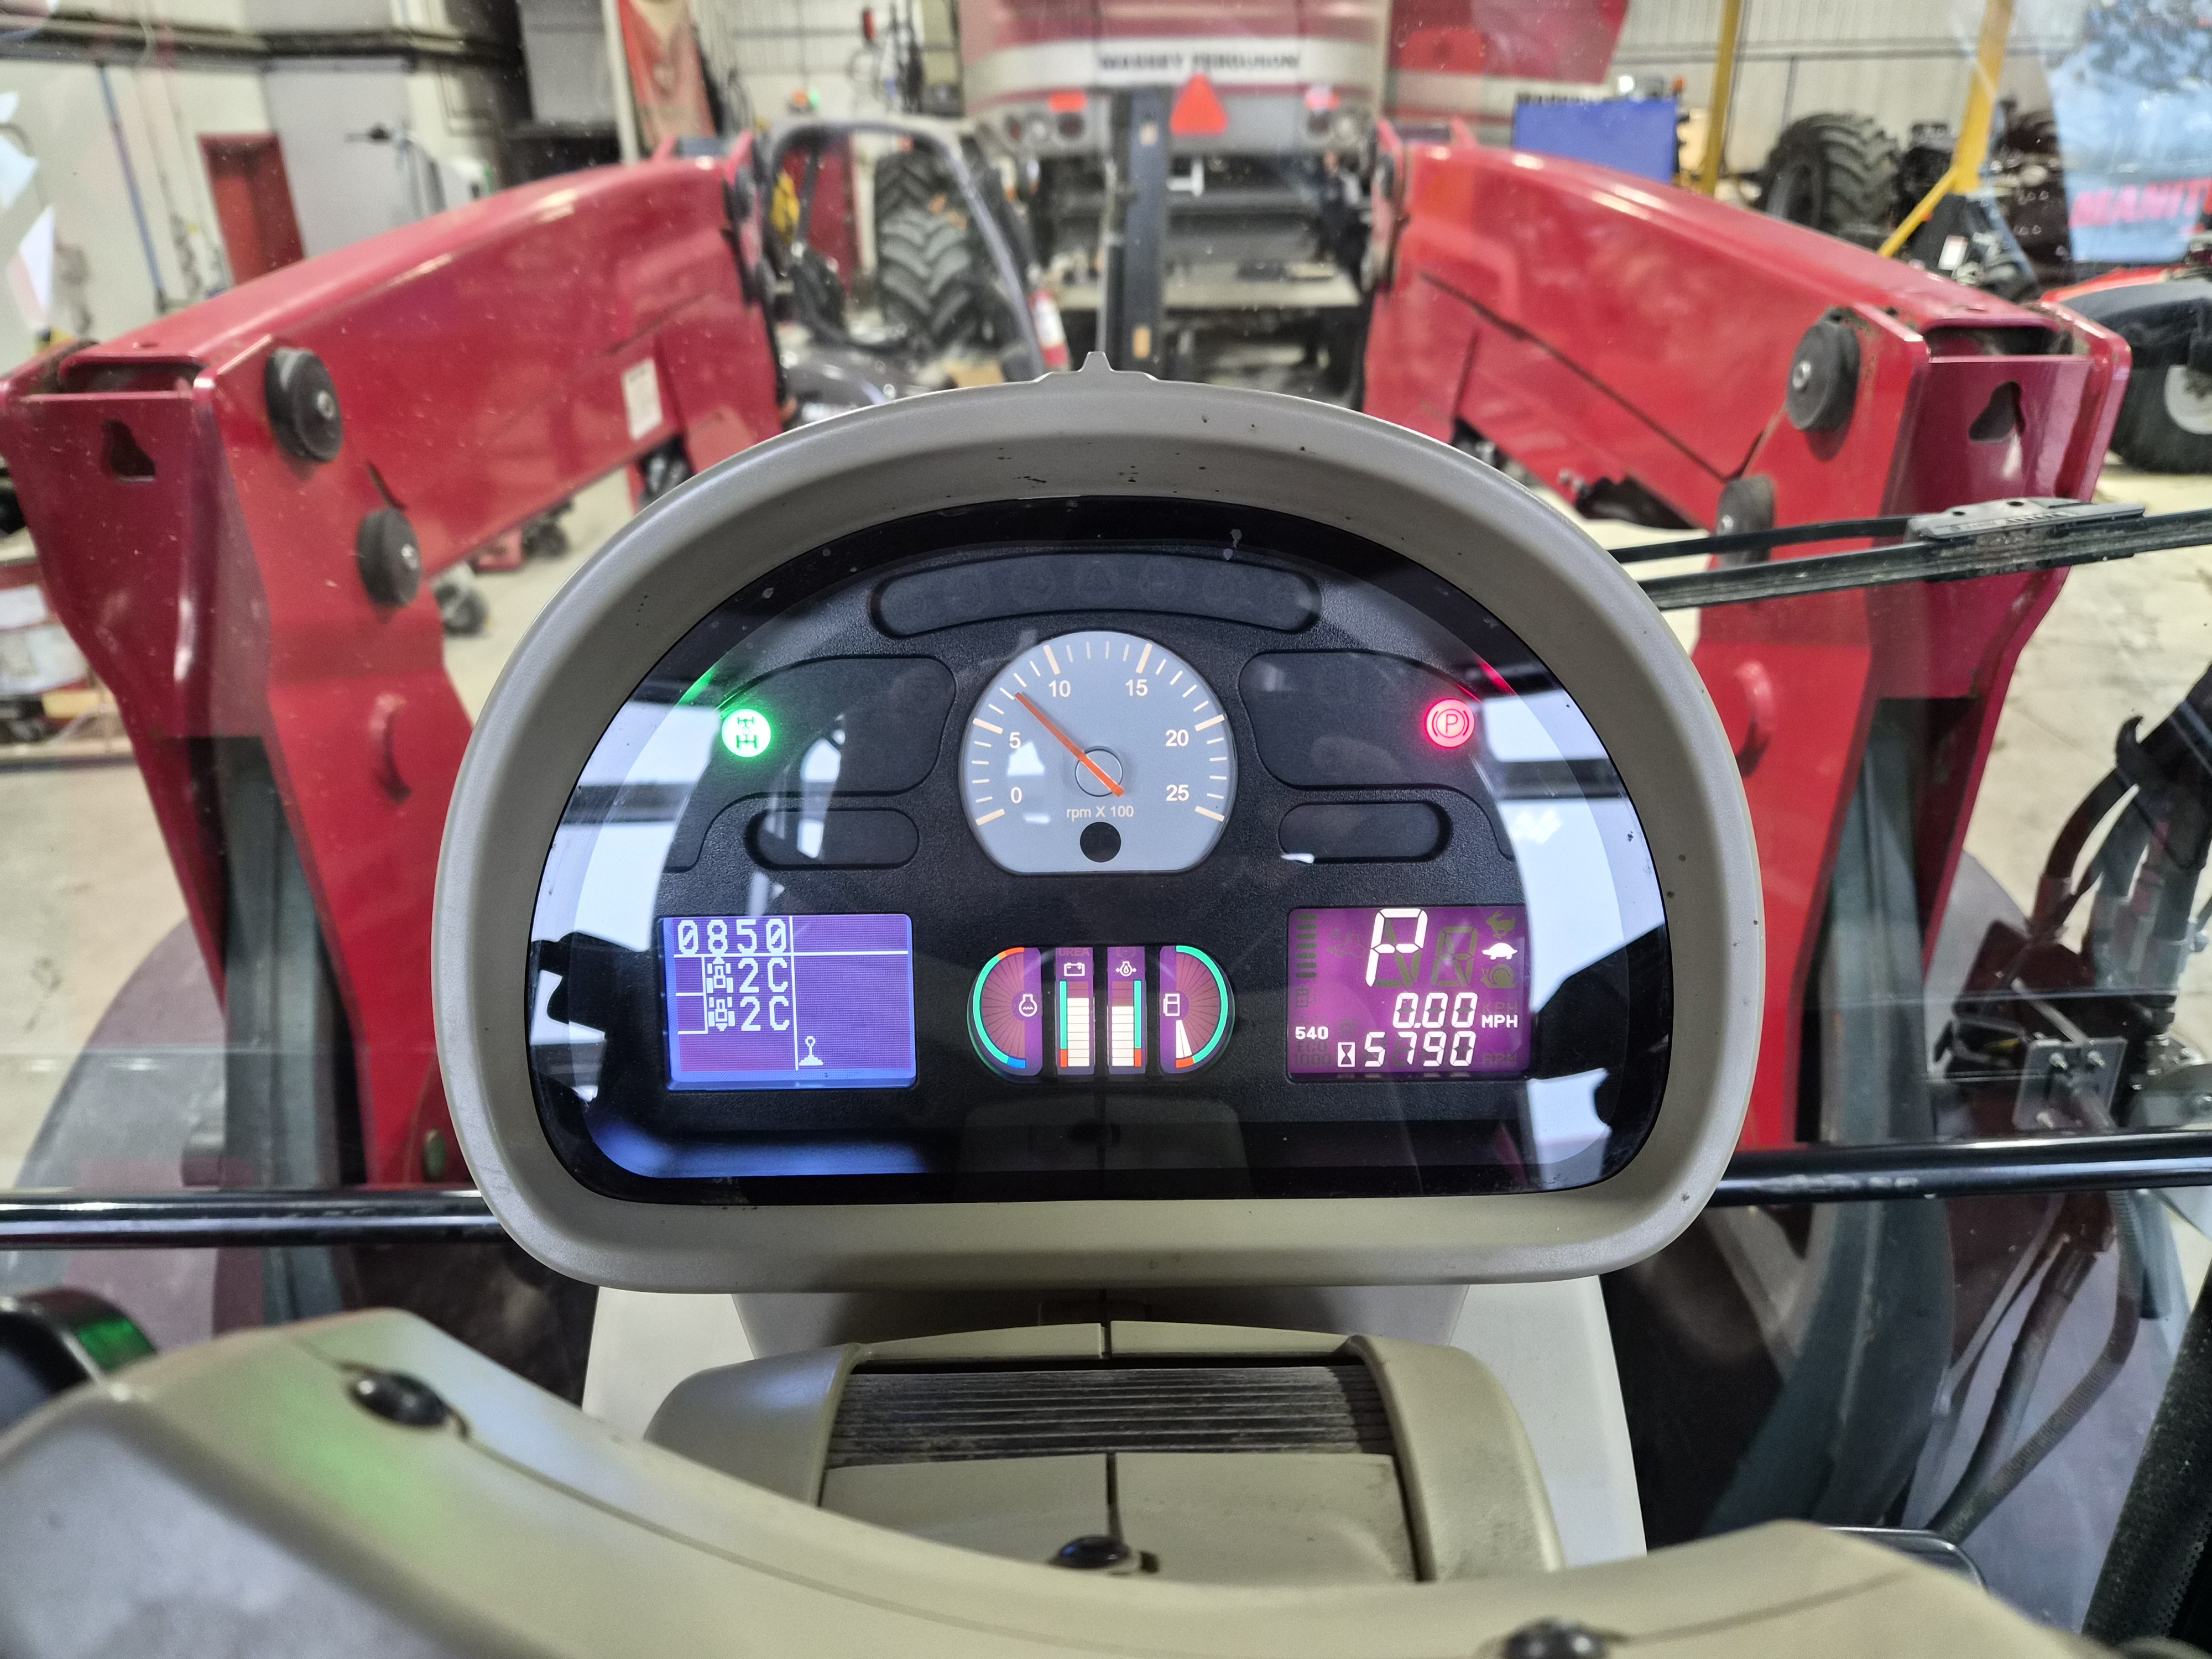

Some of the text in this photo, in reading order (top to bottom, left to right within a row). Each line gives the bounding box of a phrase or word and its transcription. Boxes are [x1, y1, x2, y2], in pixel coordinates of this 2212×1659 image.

[1049, 680, 1071, 697] 10
[1126, 680, 1147, 696] 15
[1446, 713, 1458, 733] P
[1009, 733, 1021, 749] 5
[1165, 730, 1189, 747] 20
[1010, 787, 1022, 804] 0
[1166, 785, 1189, 801] 25
[1067, 806, 1134, 822] rpm X 100
[677, 919, 786, 954] 0850
[1365, 908, 1428, 987] P
[738, 957, 788, 993] 2C
[740, 995, 790, 1031] 2C
[1392, 992, 1478, 1029] 0.00
[1481, 1014, 1518, 1028] MPH
[1295, 1026, 1329, 1040] 540
[1364, 1031, 1477, 1067] 5790
